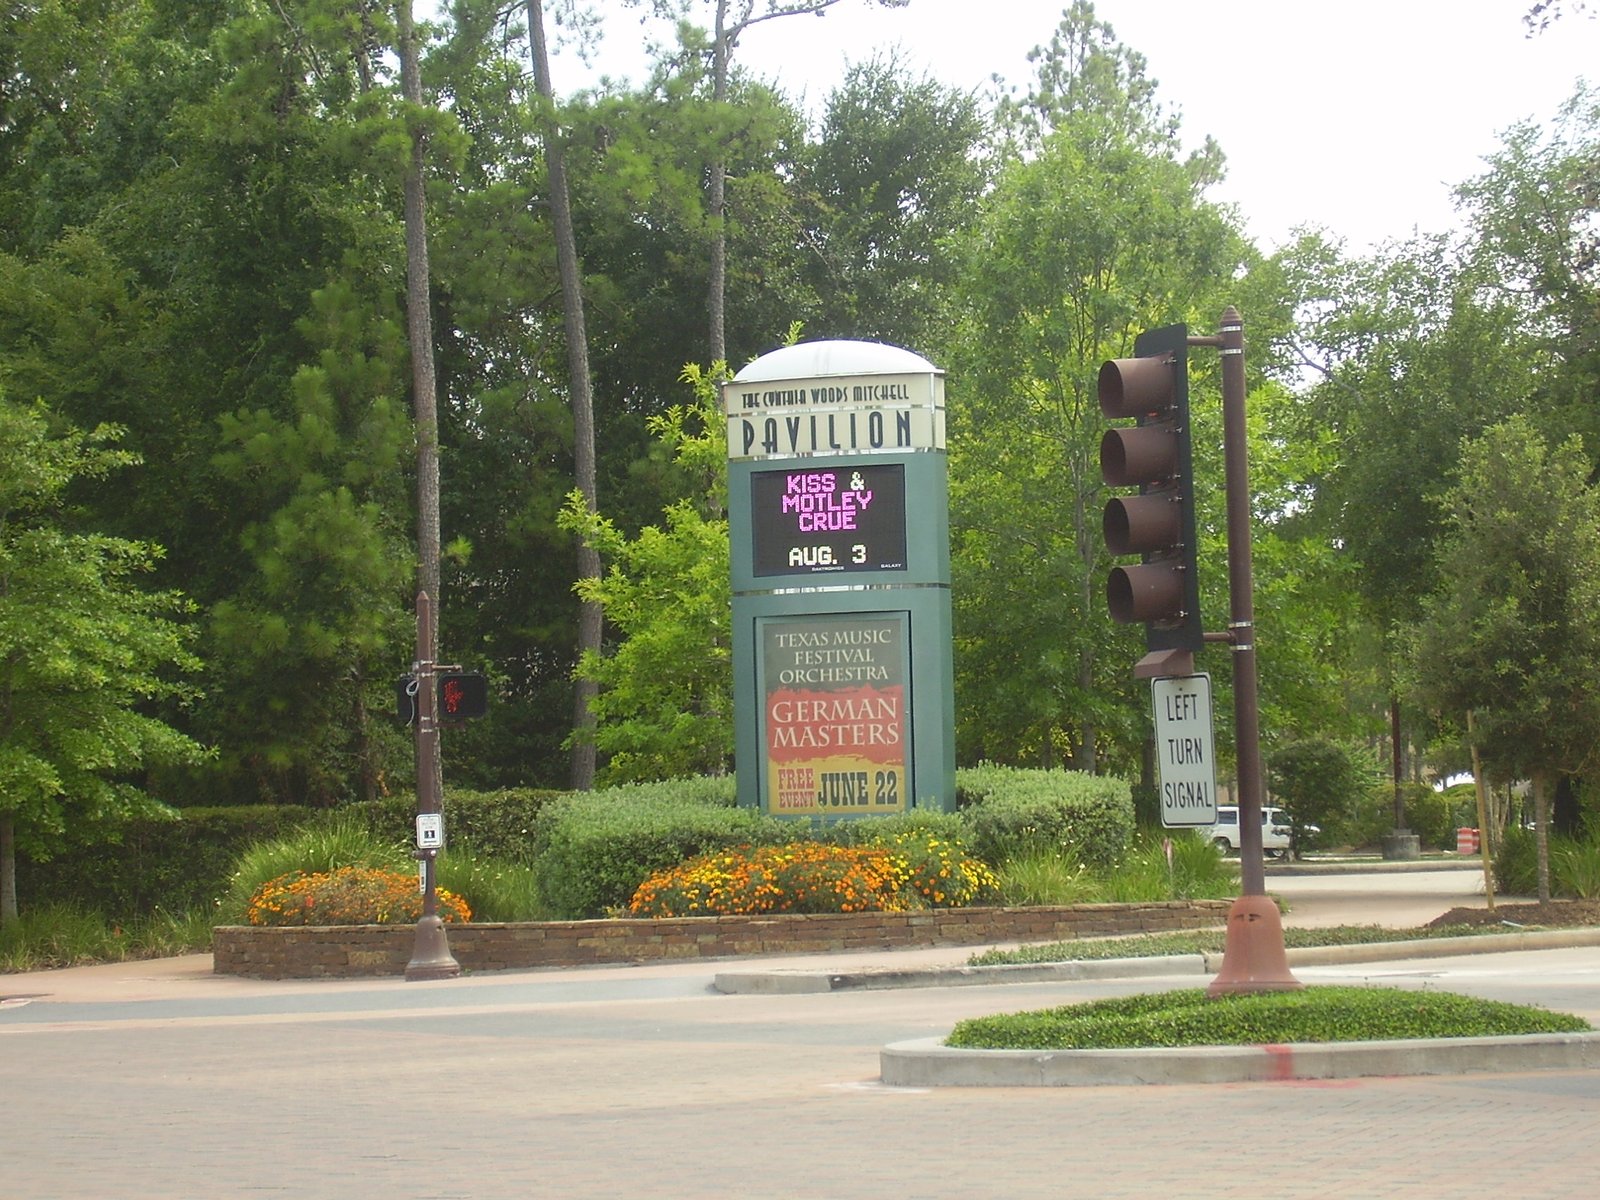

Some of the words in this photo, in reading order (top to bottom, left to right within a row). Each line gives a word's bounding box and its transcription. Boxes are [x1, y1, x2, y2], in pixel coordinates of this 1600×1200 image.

[742, 393, 760, 408] THE
[763, 389, 806, 407] CYNTHIA
[811, 387, 848, 403] WOODS
[853, 384, 909, 401] MITCHELL
[742, 410, 911, 455] PAVILION
[787, 474, 835, 493] KISS
[850, 472, 864, 491] &
[782, 491, 872, 513] MOTLEY
[799, 511, 857, 531] CRUE
[789, 546, 837, 566] AUG.
[852, 544, 866, 564] 3
[776, 632, 829, 648] TEXAS
[833, 629, 892, 645] MUSIC
[795, 648, 874, 665] FESTIVAL
[779, 666, 889, 684] ORCHESTRA
[772, 697, 898, 723] GERMAN
[1166, 694, 1197, 721] LEFT
[773, 722, 900, 749] MASTERS
[1168, 738, 1203, 764] TURN
[778, 768, 814, 790] FREE
[818, 771, 868, 806] JUNE
[875, 770, 897, 805] 22
[779, 791, 814, 808] EVENT
[1165, 781, 1212, 808] SIGNAL
